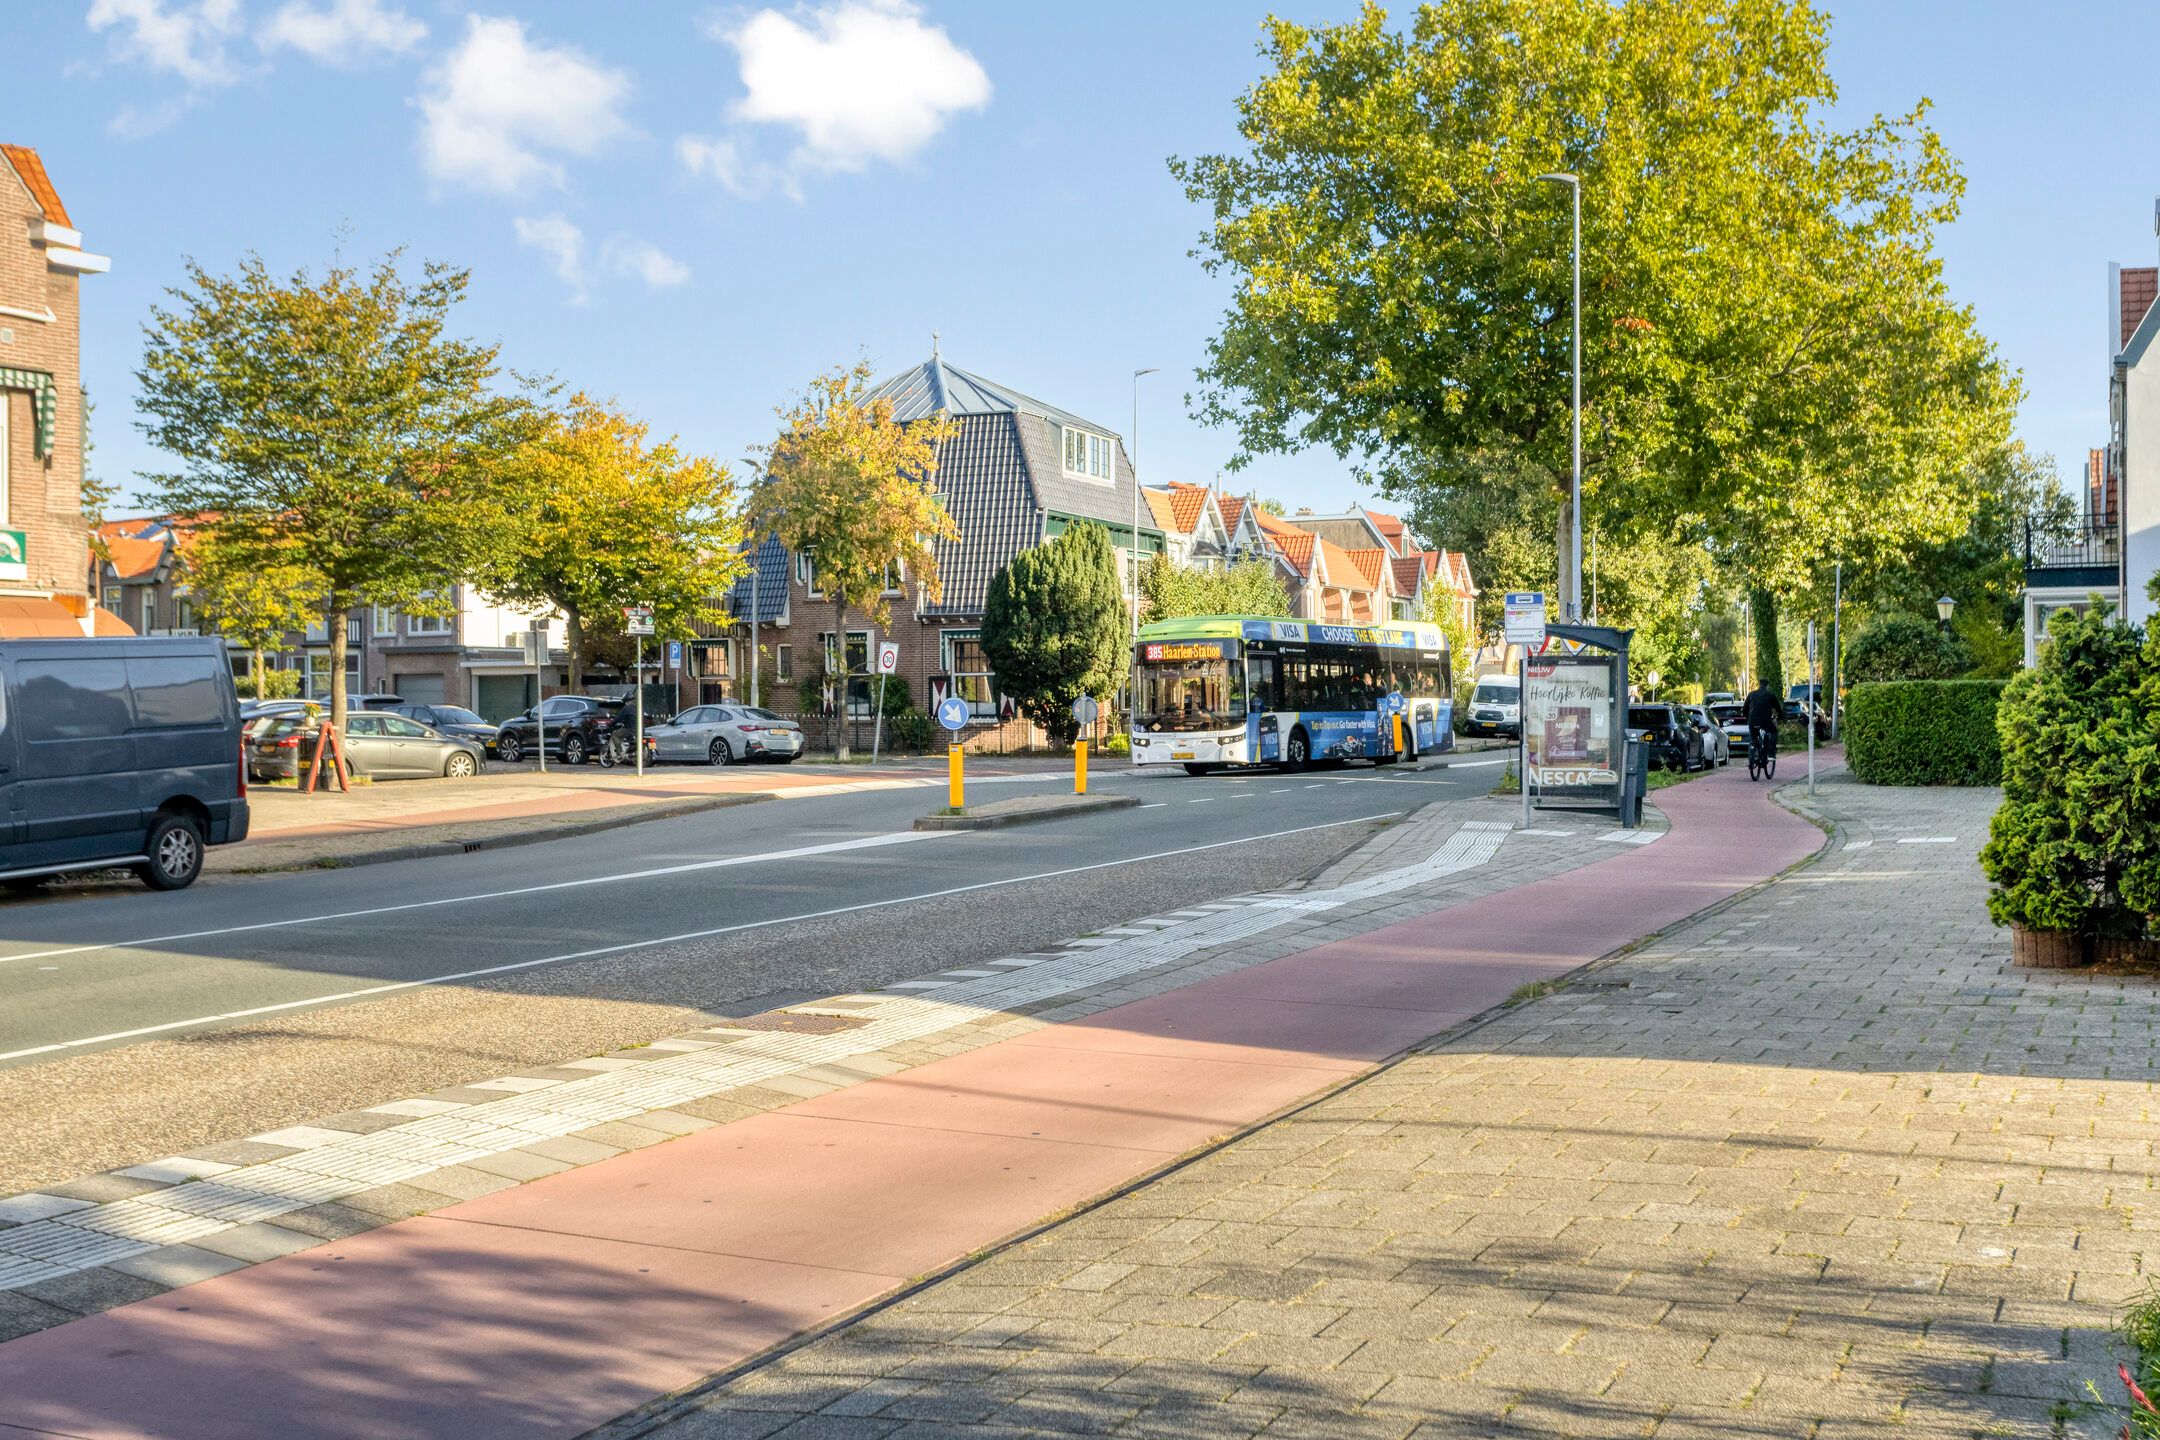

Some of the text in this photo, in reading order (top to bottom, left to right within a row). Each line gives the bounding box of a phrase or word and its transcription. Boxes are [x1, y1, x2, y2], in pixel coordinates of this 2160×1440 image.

[1280, 624, 1300, 639] VISA
[1321, 626, 1405, 645] CHOOSE THE FAST LANE
[1422, 633, 1438, 647] VISA
[671, 645, 678, 658] P
[1148, 643, 1220, 659] 385 Haarlem Station
[884, 655, 893, 663] 30
[1530, 685, 1606, 703] Heerlijke Koffie
[1339, 720, 1346, 729] Go
[1345, 720, 1358, 729] faster
[1358, 720, 1366, 729] with
